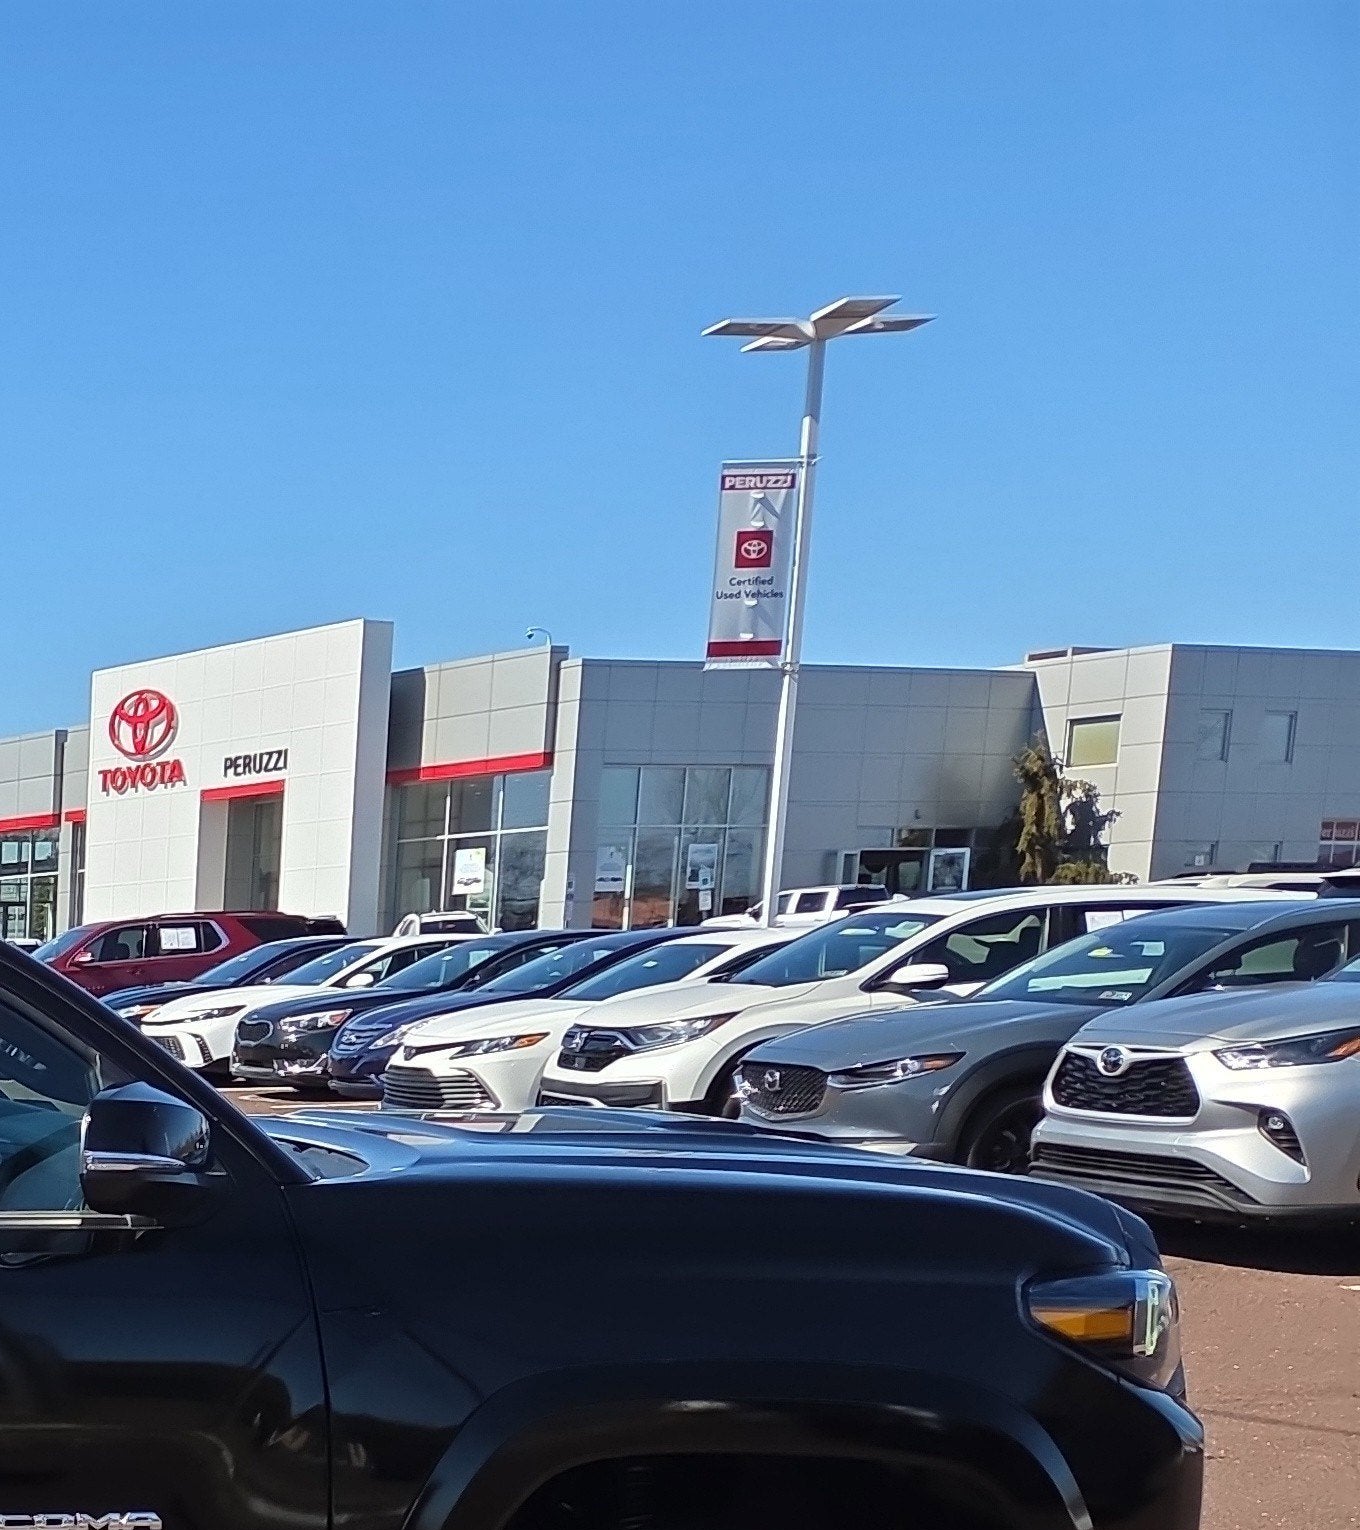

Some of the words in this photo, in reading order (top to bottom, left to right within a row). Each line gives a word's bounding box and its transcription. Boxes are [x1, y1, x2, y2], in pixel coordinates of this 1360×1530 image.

[724, 474, 792, 489] PERUZZI
[729, 576, 774, 587] Certified
[716, 590, 742, 600] Used
[744, 589, 784, 600] Vehicles
[223, 749, 289, 778] PERUZZI
[98, 759, 186, 795] TOYOTA
